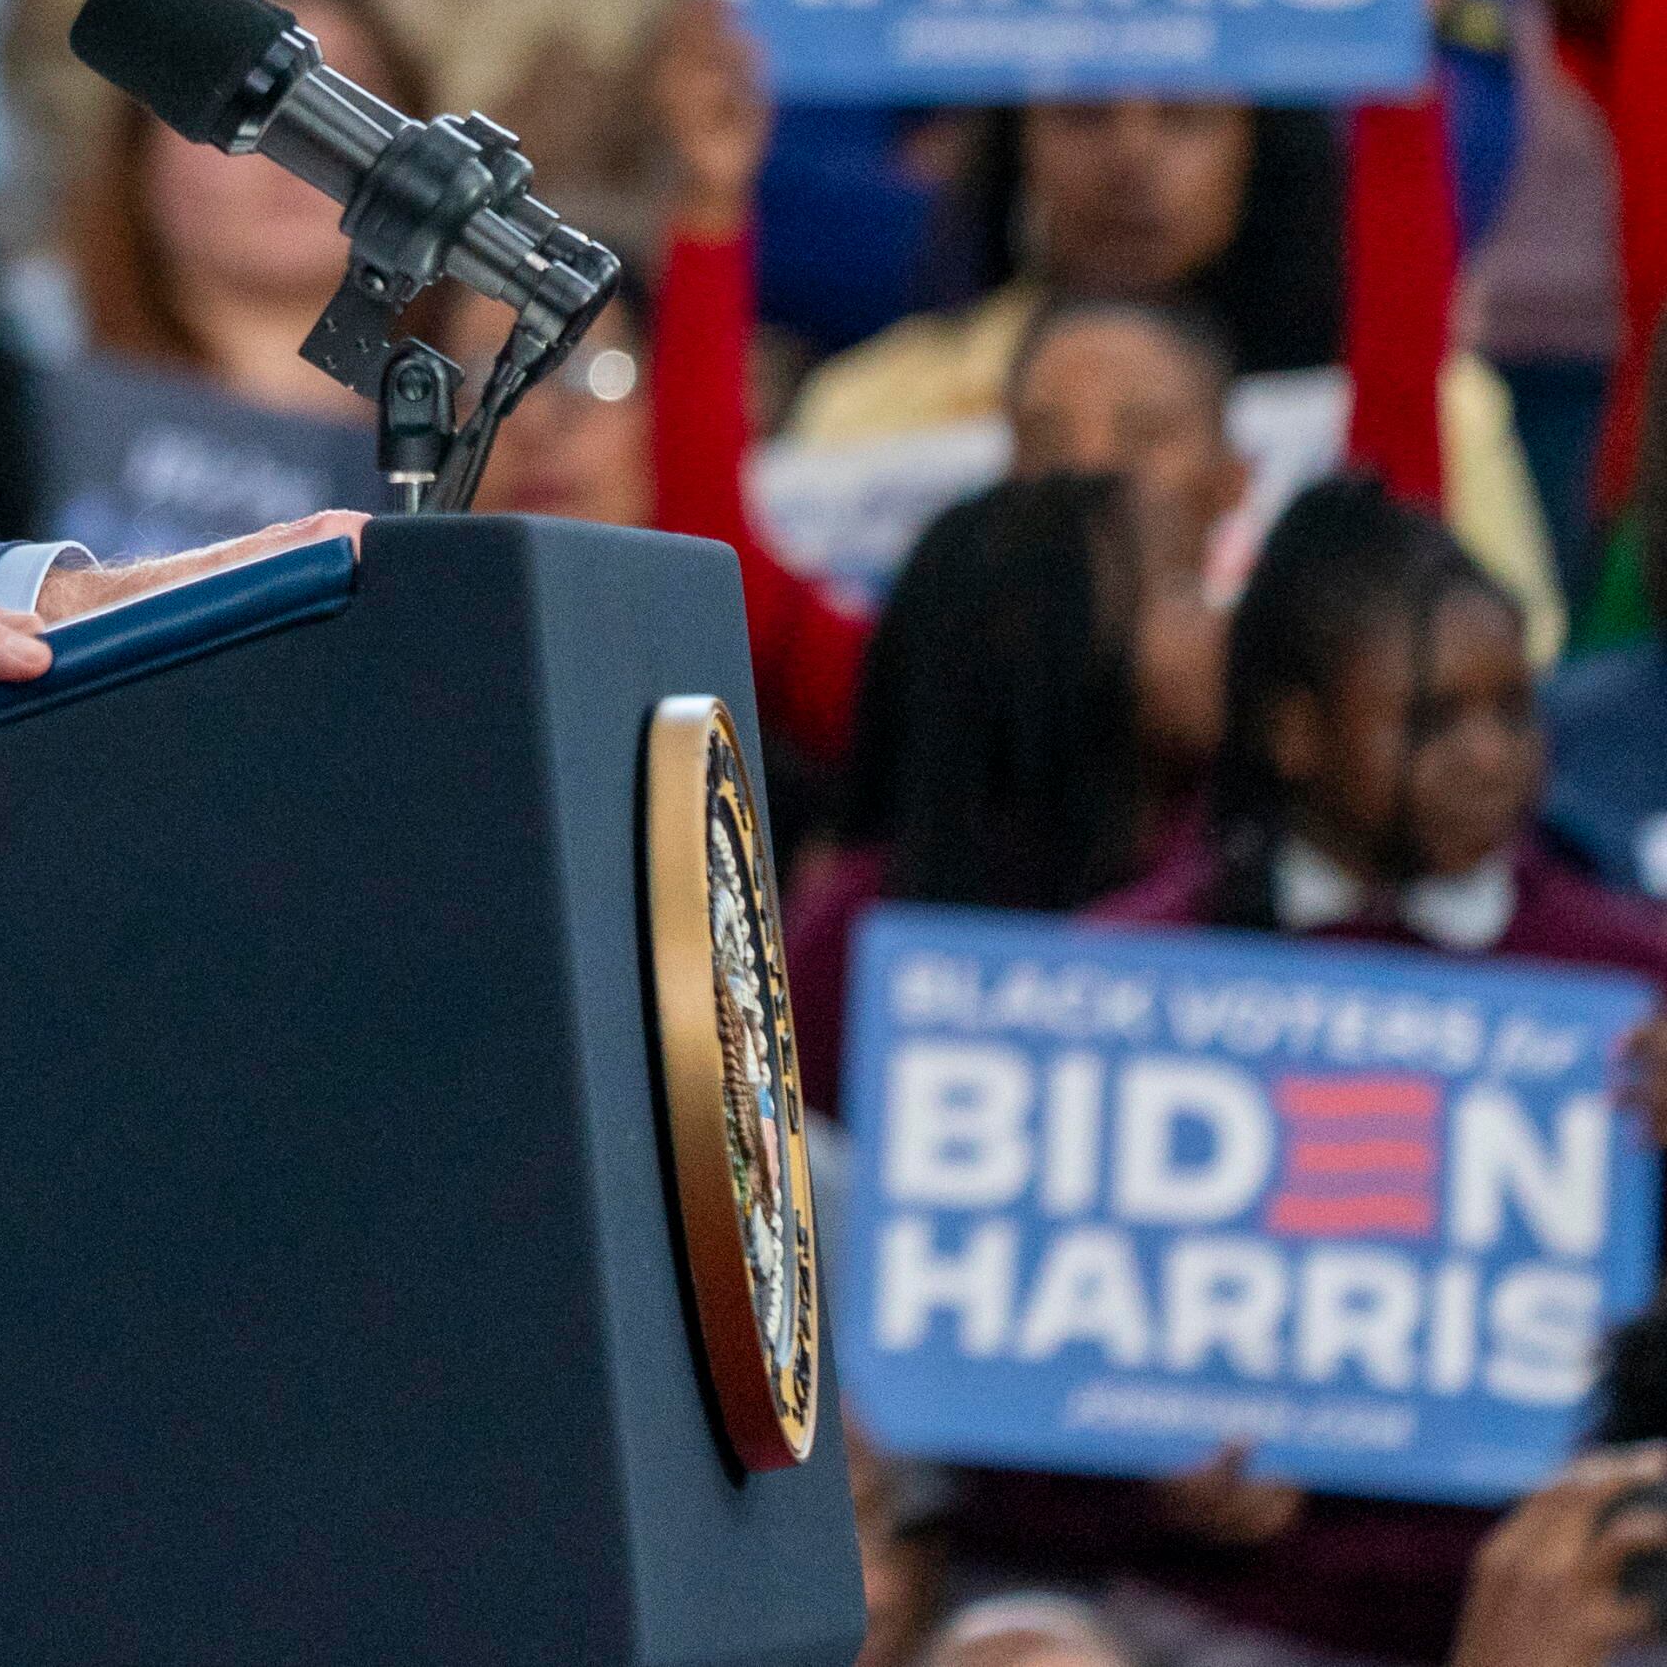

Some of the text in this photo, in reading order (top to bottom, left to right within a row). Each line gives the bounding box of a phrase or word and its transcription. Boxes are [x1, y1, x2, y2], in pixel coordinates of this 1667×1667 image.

[887, 951, 1156, 1037] BLACK
[1167, 980, 1482, 1072] VOTERS
[882, 1037, 1613, 1259] BIDEN
[874, 1213, 1603, 1407] HARRIS
